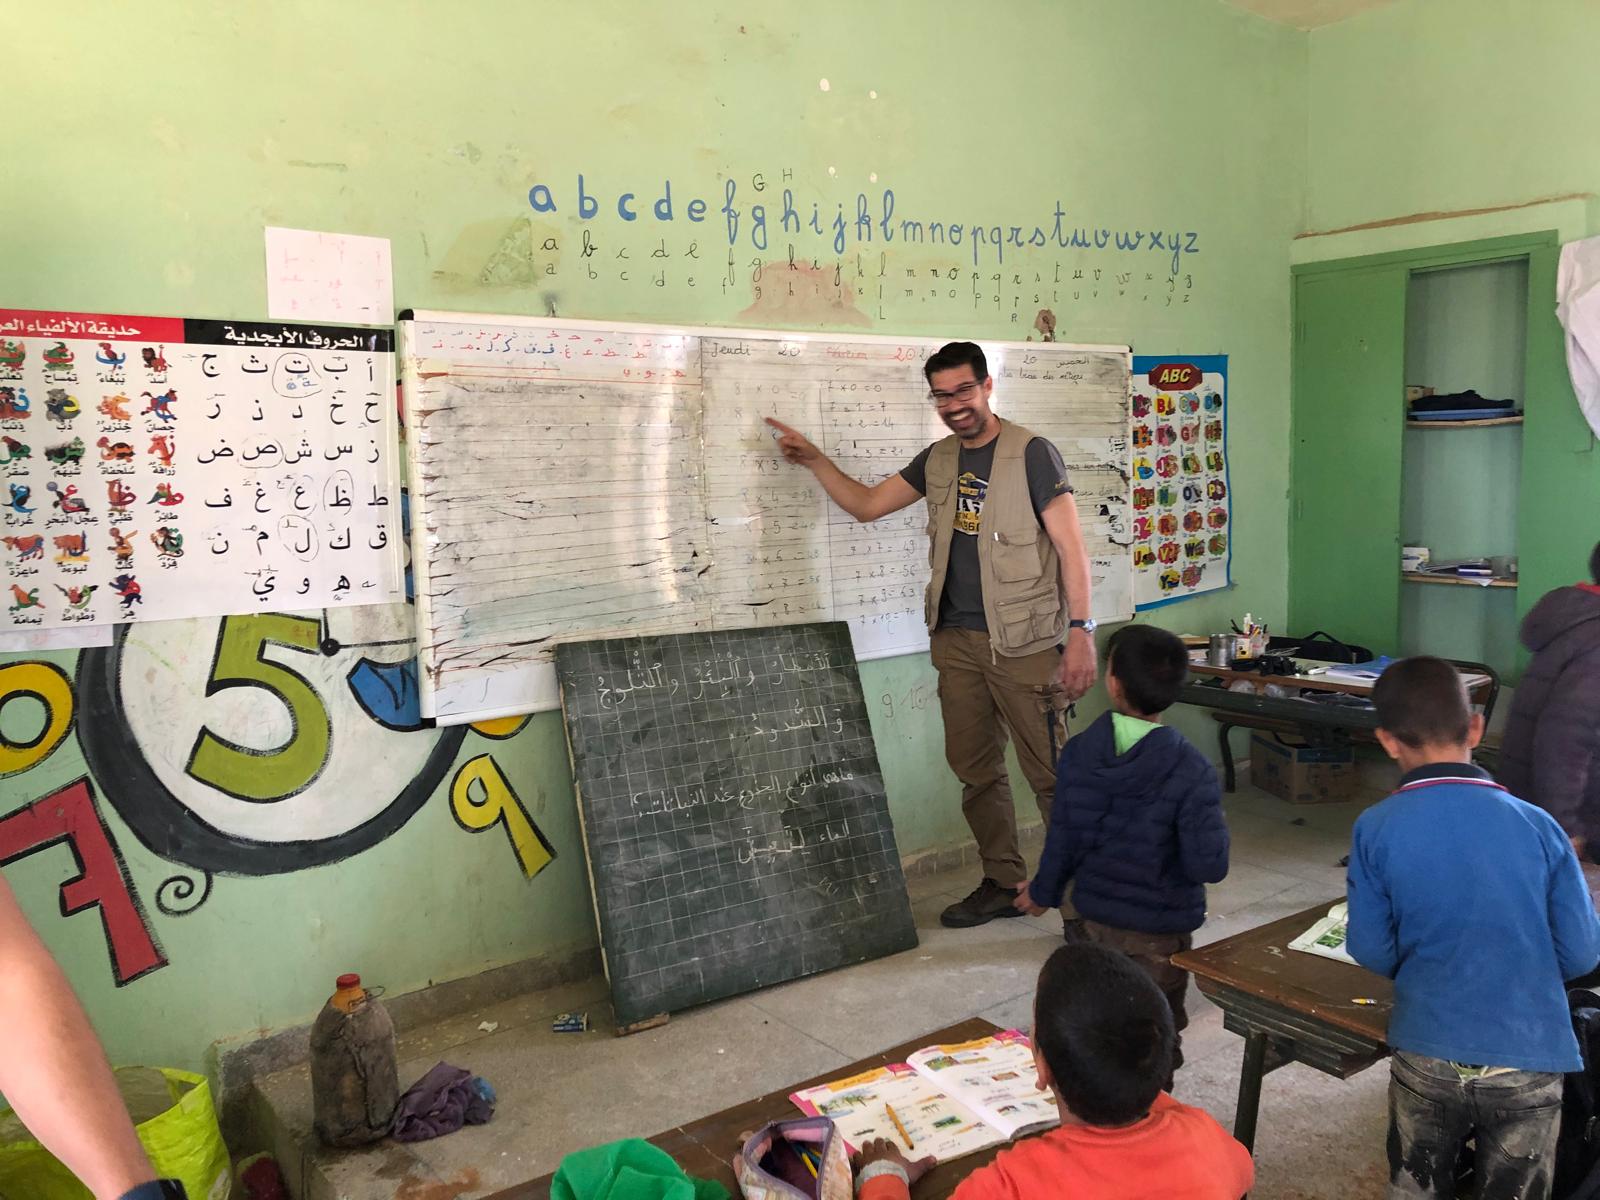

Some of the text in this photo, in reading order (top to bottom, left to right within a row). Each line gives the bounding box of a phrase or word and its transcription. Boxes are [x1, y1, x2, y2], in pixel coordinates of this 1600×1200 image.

[753, 168, 793, 192] G H
[88, 320, 141, 338] حديقة
[224, 326, 363, 350] الحروف الأبجدية
[711, 342, 751, 358] Jeudi
[777, 344, 800, 357] 20
[201, 353, 373, 381] أ ب ت ث ج
[1159, 368, 1191, 383] ABC
[207, 395, 381, 425] ح خ د ذ ر
[197, 439, 379, 464] ز س ش ص ض
[204, 482, 389, 513] ط ظ ع غ ف
[211, 524, 387, 555] ق ك ل م ن
[253, 576, 275, 601] ي
[296, 577, 310, 594] و
[185, 612, 332, 803] 5
[449, 752, 557, 880] 9
